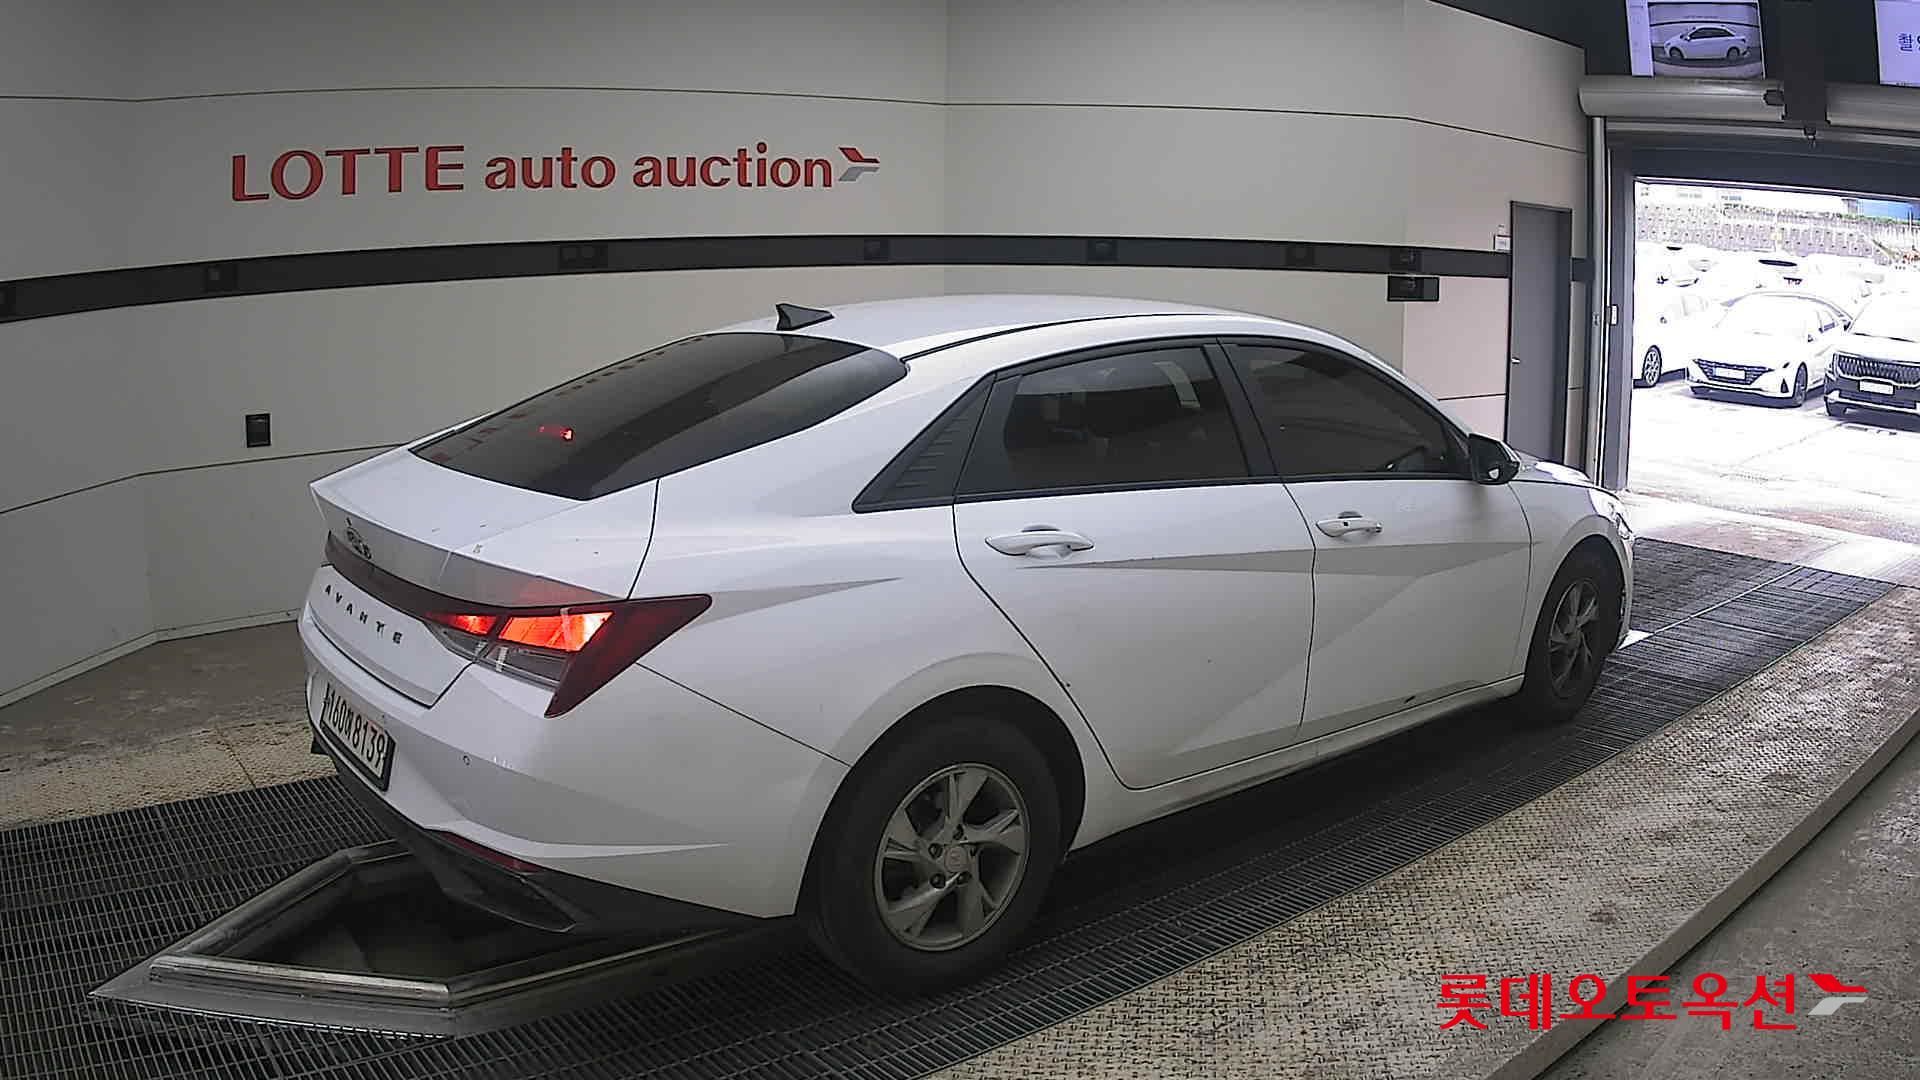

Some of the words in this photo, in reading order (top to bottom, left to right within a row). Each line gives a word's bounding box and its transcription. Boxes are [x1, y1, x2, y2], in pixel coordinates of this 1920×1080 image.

[232, 145, 465, 201] LOTTE
[484, 147, 616, 189] auto
[632, 142, 833, 188] auction
[325, 584, 403, 644] AVANTE
